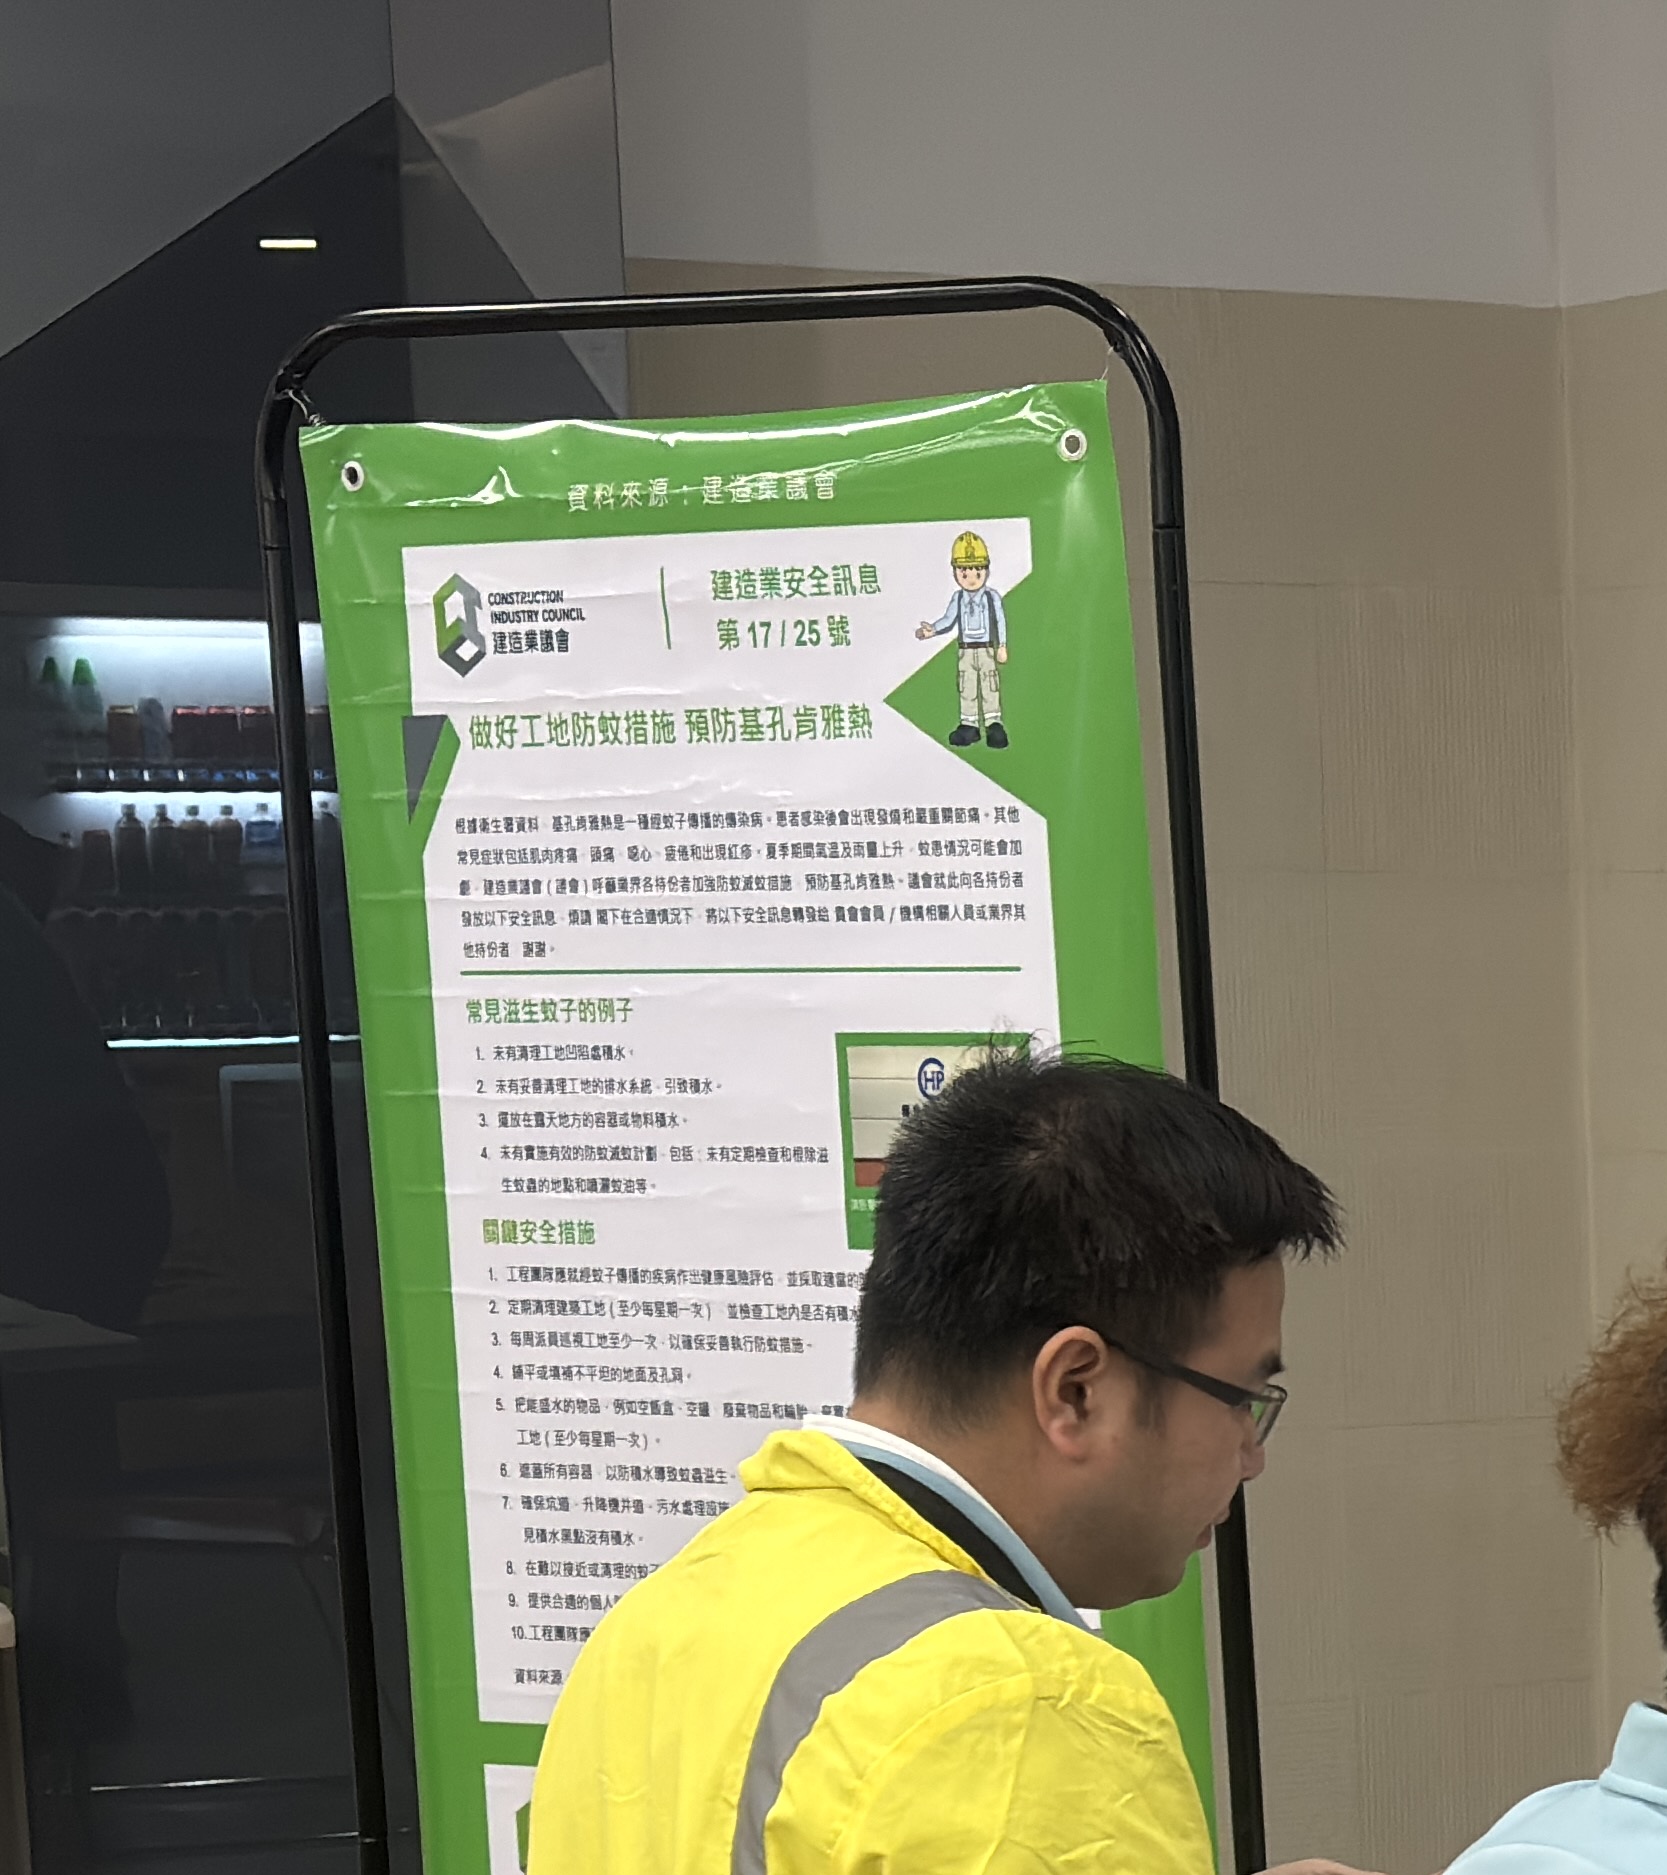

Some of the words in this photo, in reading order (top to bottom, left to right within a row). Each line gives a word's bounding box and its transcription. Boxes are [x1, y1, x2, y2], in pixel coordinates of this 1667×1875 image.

[711, 563, 882, 601] 建造業安全訊息
[488, 590, 564, 606] CONSTRUCTION
[491, 610, 540, 624] INDUSTRY
[542, 608, 586, 622] COUNCIL
[492, 628, 569, 655] 建造業議會
[717, 617, 740, 650] 第
[747, 620, 771, 650] 17
[794, 618, 821, 647] 25
[827, 614, 851, 648] 號
[469, 708, 677, 750] 做好工地防蚊措施
[684, 703, 873, 744] 預防基孔肯雅熱
[465, 998, 633, 1024] 常見滋生蚊子的例子
